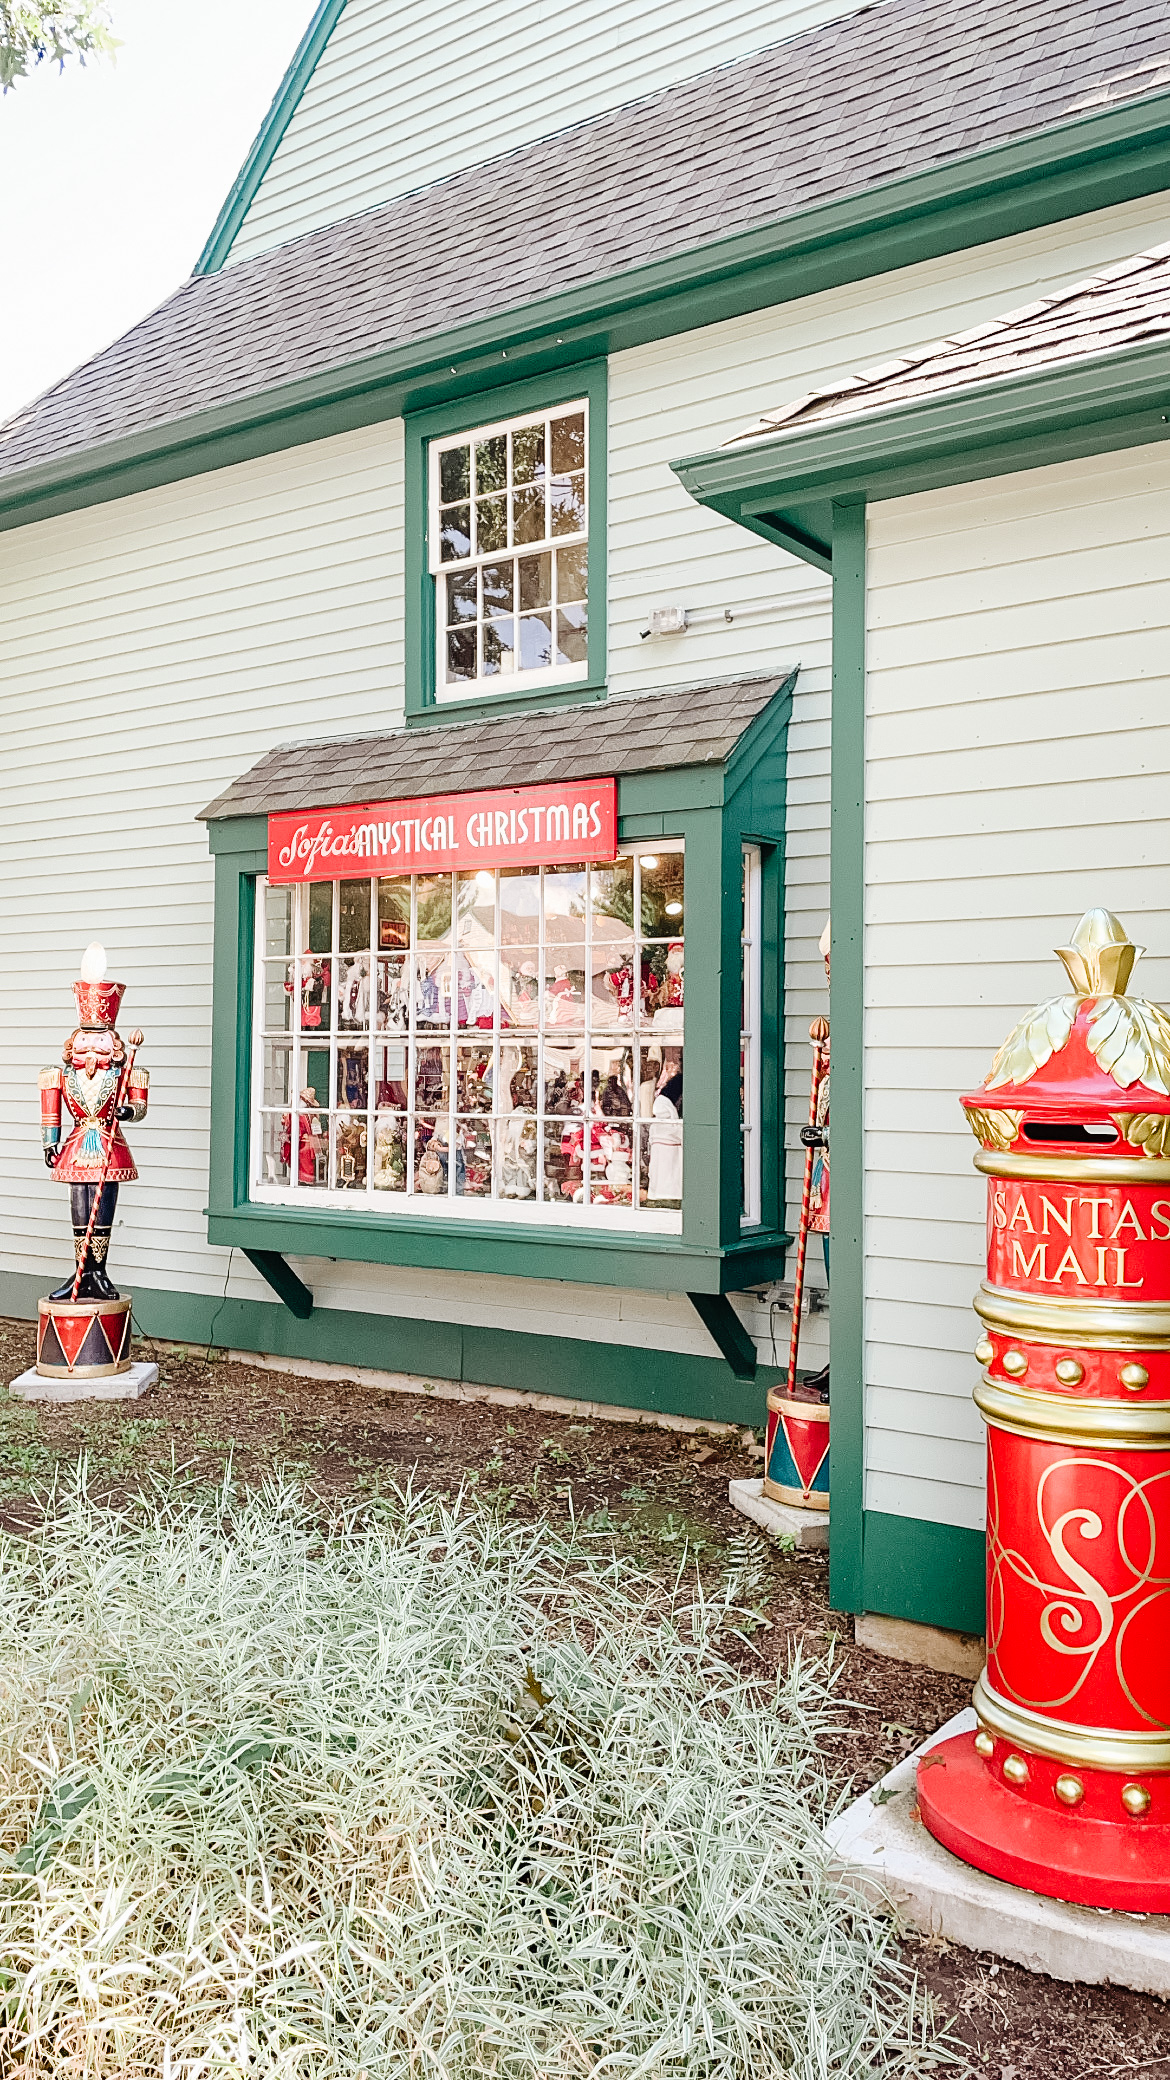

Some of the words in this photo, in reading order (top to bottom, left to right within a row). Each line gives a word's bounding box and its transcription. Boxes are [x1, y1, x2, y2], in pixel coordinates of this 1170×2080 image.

[278, 820, 366, 875] Sofia's
[358, 815, 460, 857] MYSTICAL
[466, 800, 602, 848] CHRISTMAS
[993, 1190, 1170, 1241] SANTAS
[1011, 1239, 1144, 1288] MAIL
